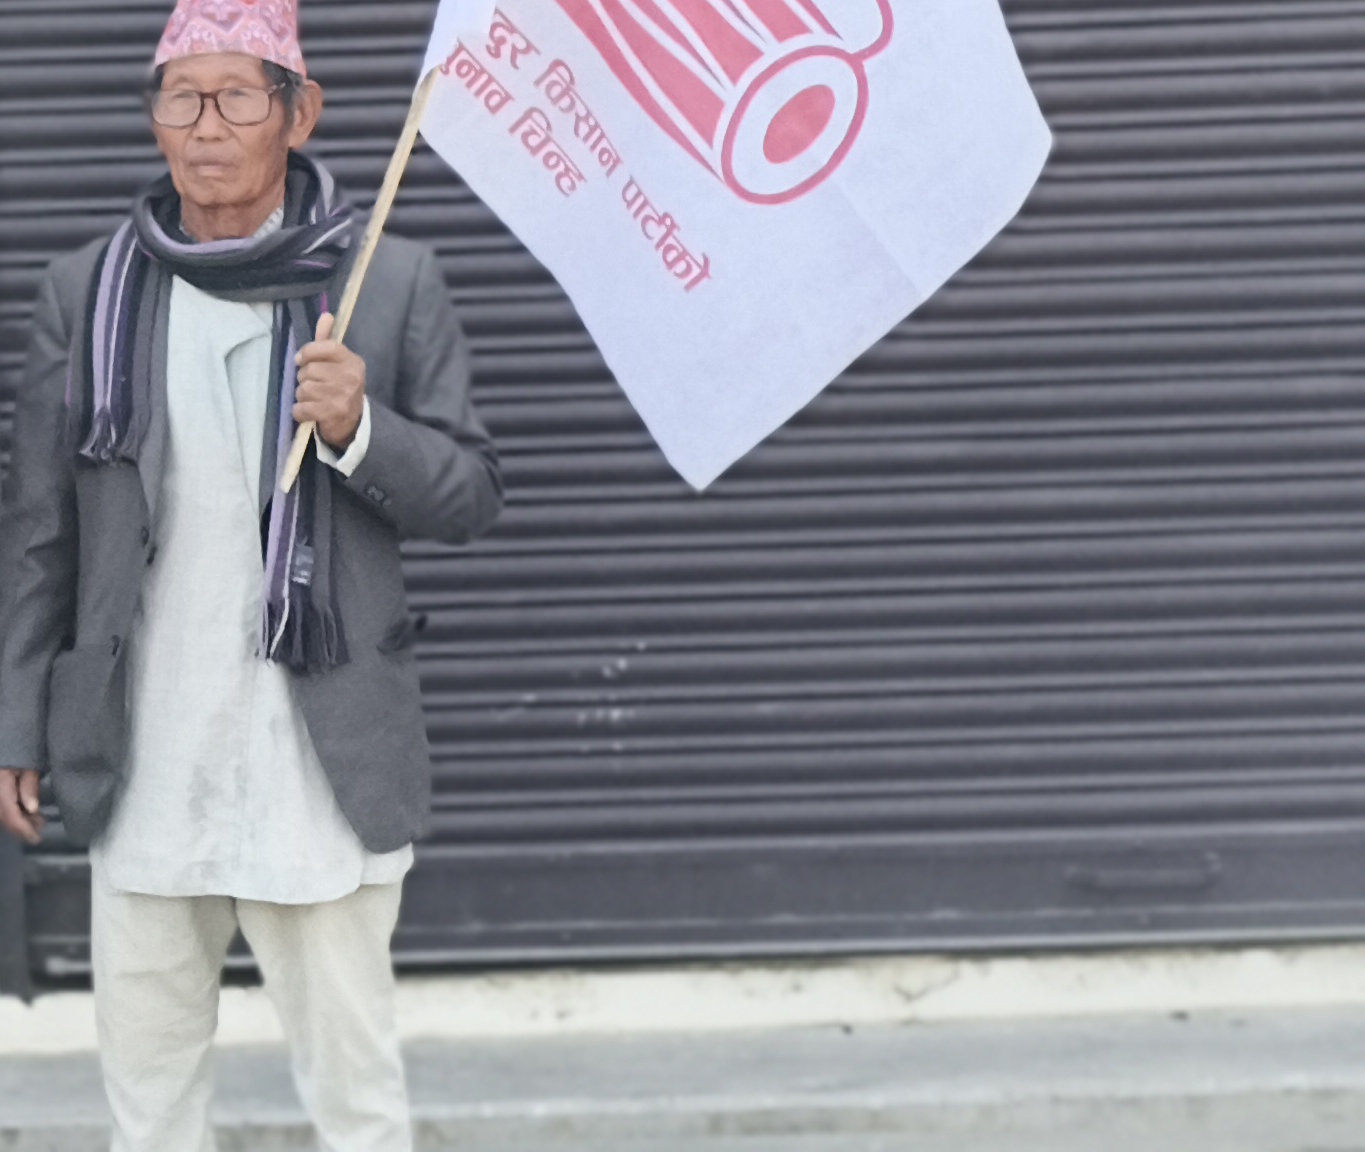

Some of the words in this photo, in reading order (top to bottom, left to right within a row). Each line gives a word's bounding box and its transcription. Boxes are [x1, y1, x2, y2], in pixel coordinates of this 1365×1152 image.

[508, 106, 588, 198] चिन्ह
[533, 58, 623, 178] किसान
[621, 174, 712, 293] पार्टीको
